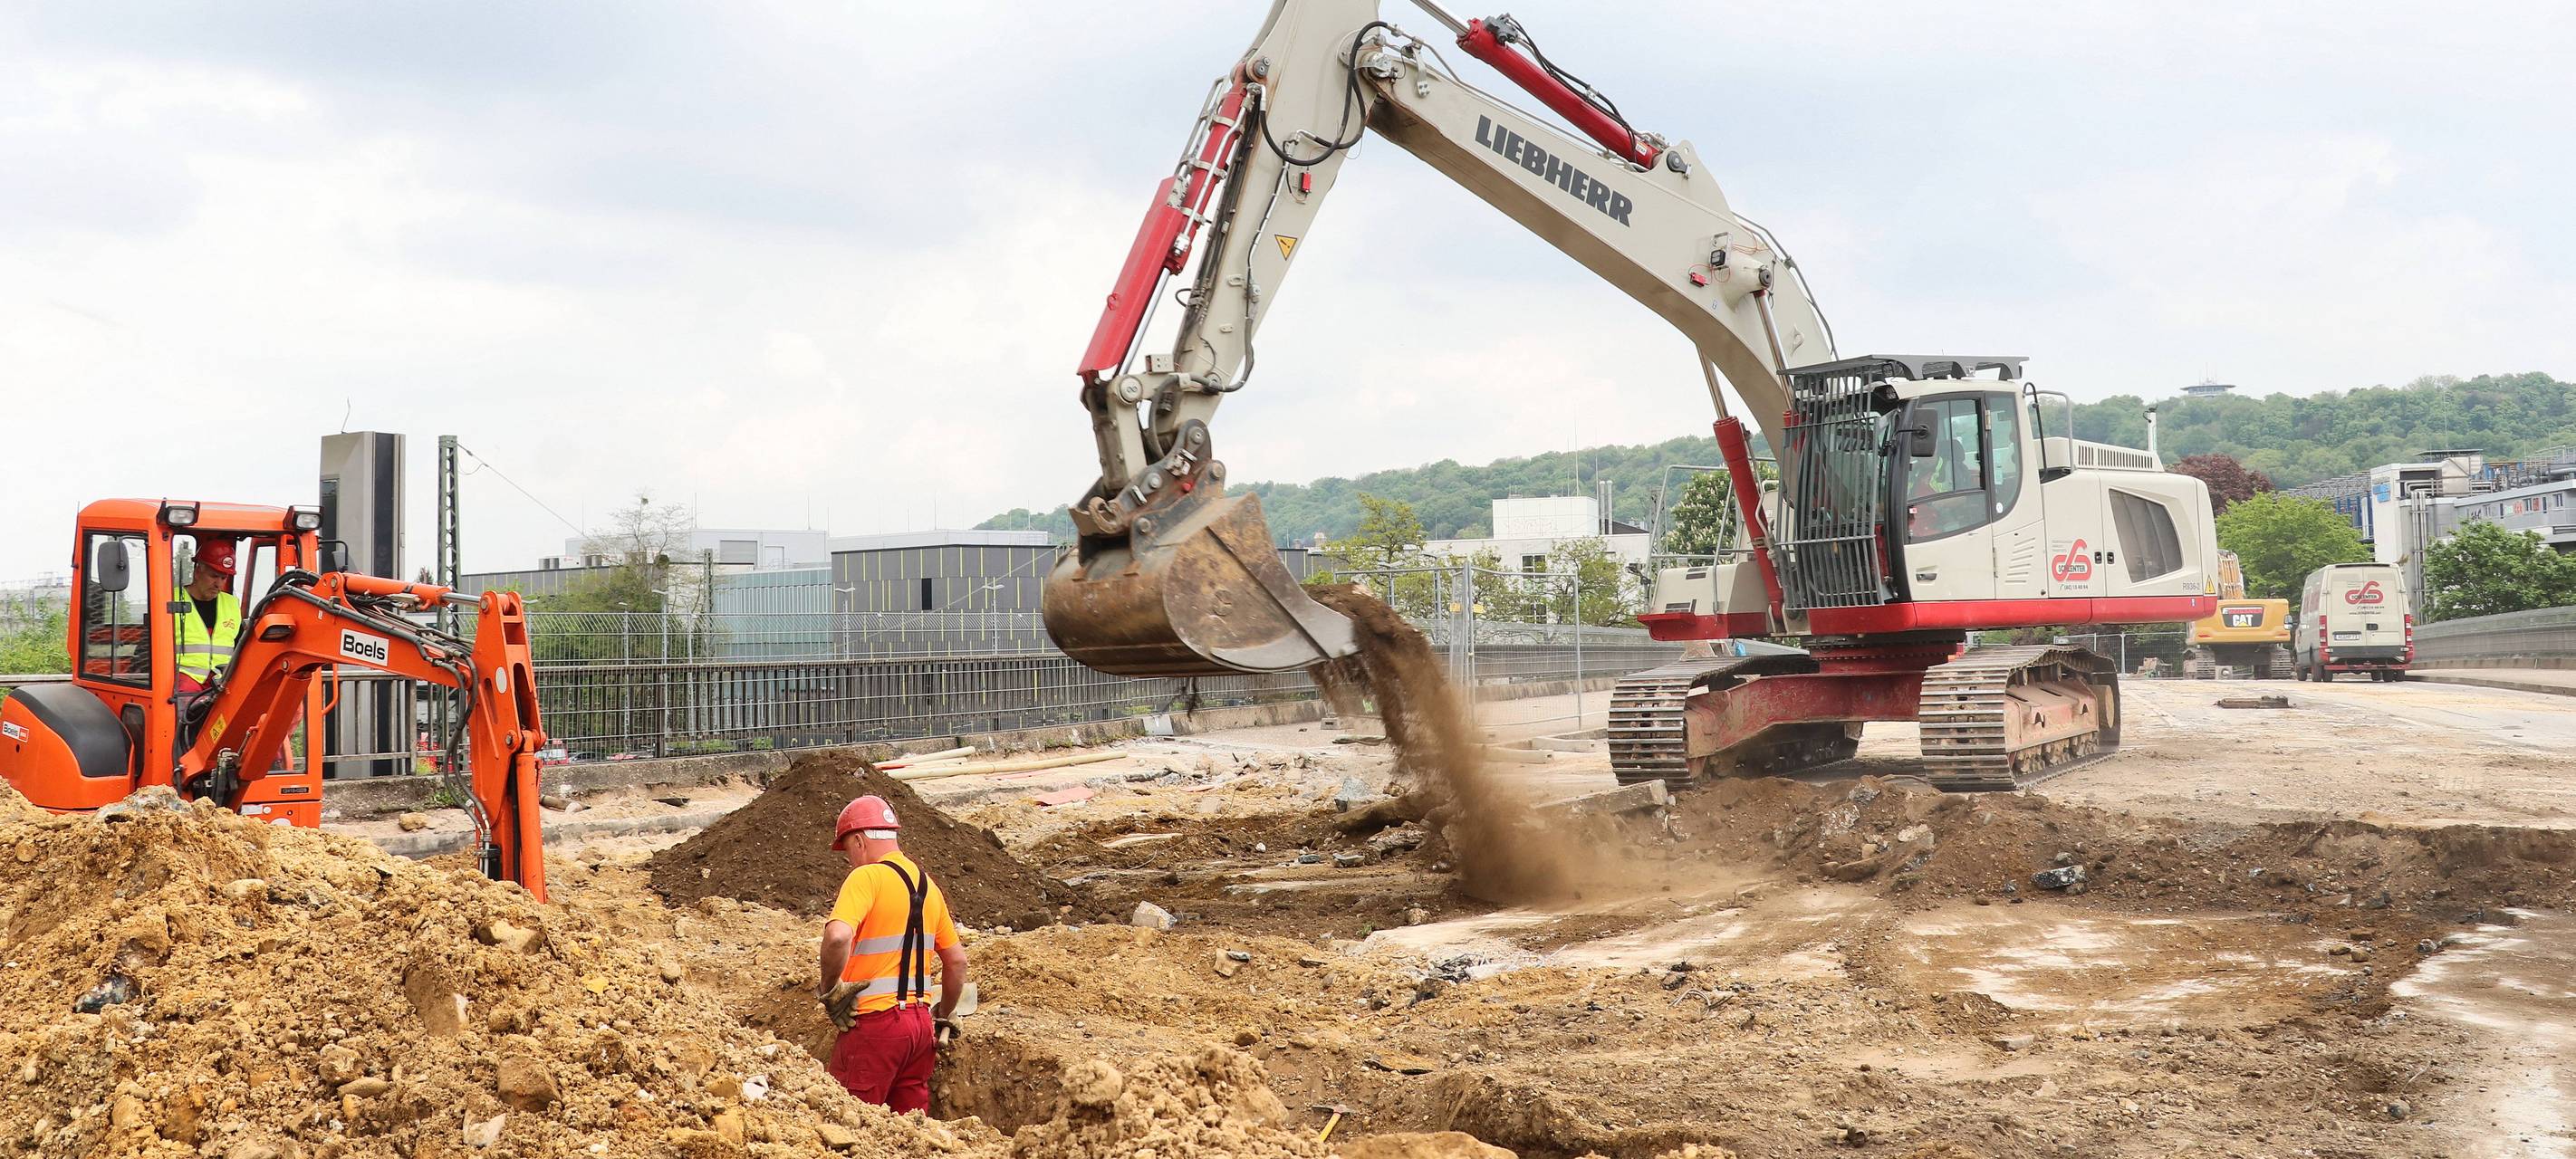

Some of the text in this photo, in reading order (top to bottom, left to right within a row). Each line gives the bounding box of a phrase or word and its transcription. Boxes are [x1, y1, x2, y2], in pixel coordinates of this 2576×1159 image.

[1475, 114, 1633, 227] LIEBHERR
[2233, 614, 2254, 627] CAT
[343, 634, 385, 660] Boels
[4, 723, 18, 736] Boels
